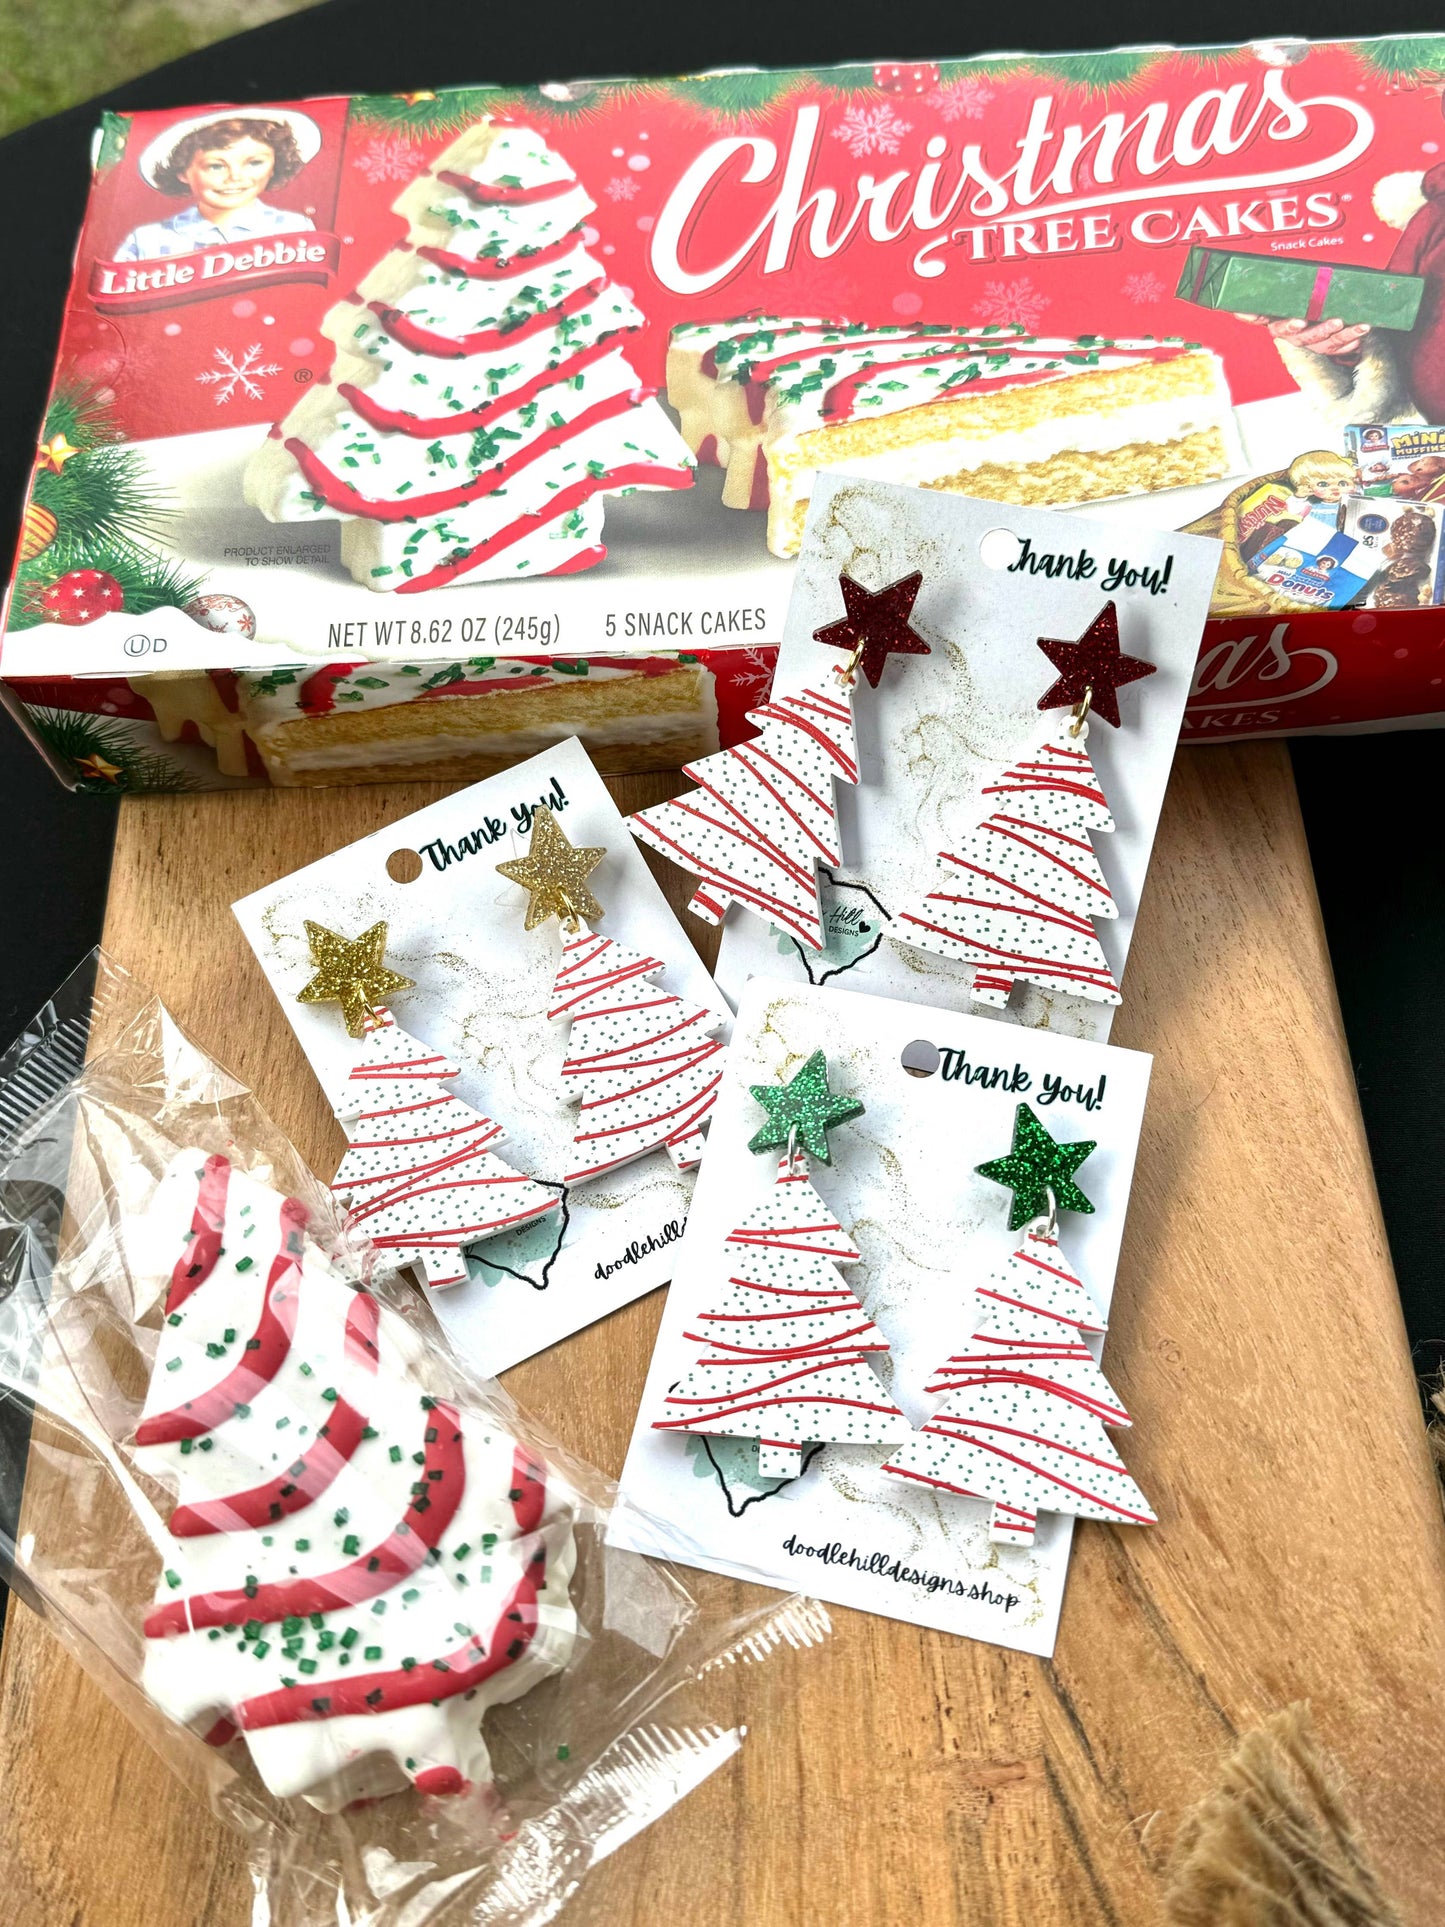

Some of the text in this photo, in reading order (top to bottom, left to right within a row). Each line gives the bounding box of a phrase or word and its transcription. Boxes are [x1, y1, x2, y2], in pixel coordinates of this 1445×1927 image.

[650, 69, 1374, 294] Christmas
[955, 215, 1116, 260] TREE
[1271, 237, 1344, 251] Snack Cakes
[100, 240, 326, 294] Little Debbie
[224, 544, 331, 557] PRODUCT ENLARGED
[245, 554, 330, 566] TO SHOW DETAIL
[1101, 555, 1174, 595] you!
[1266, 573, 1334, 600] Donuts
[328, 608, 767, 648] NET WT 8.62 OZ (245g) 5 SNACK CAKES
[418, 776, 570, 872] Thank yu!
[828, 925, 859, 937] DESIGNS
[829, 905, 865, 926] Hill
[938, 1047, 1107, 1112] Thank you!
[515, 1215, 547, 1236] DESIGNS
[594, 1216, 687, 1280] doodlehill
